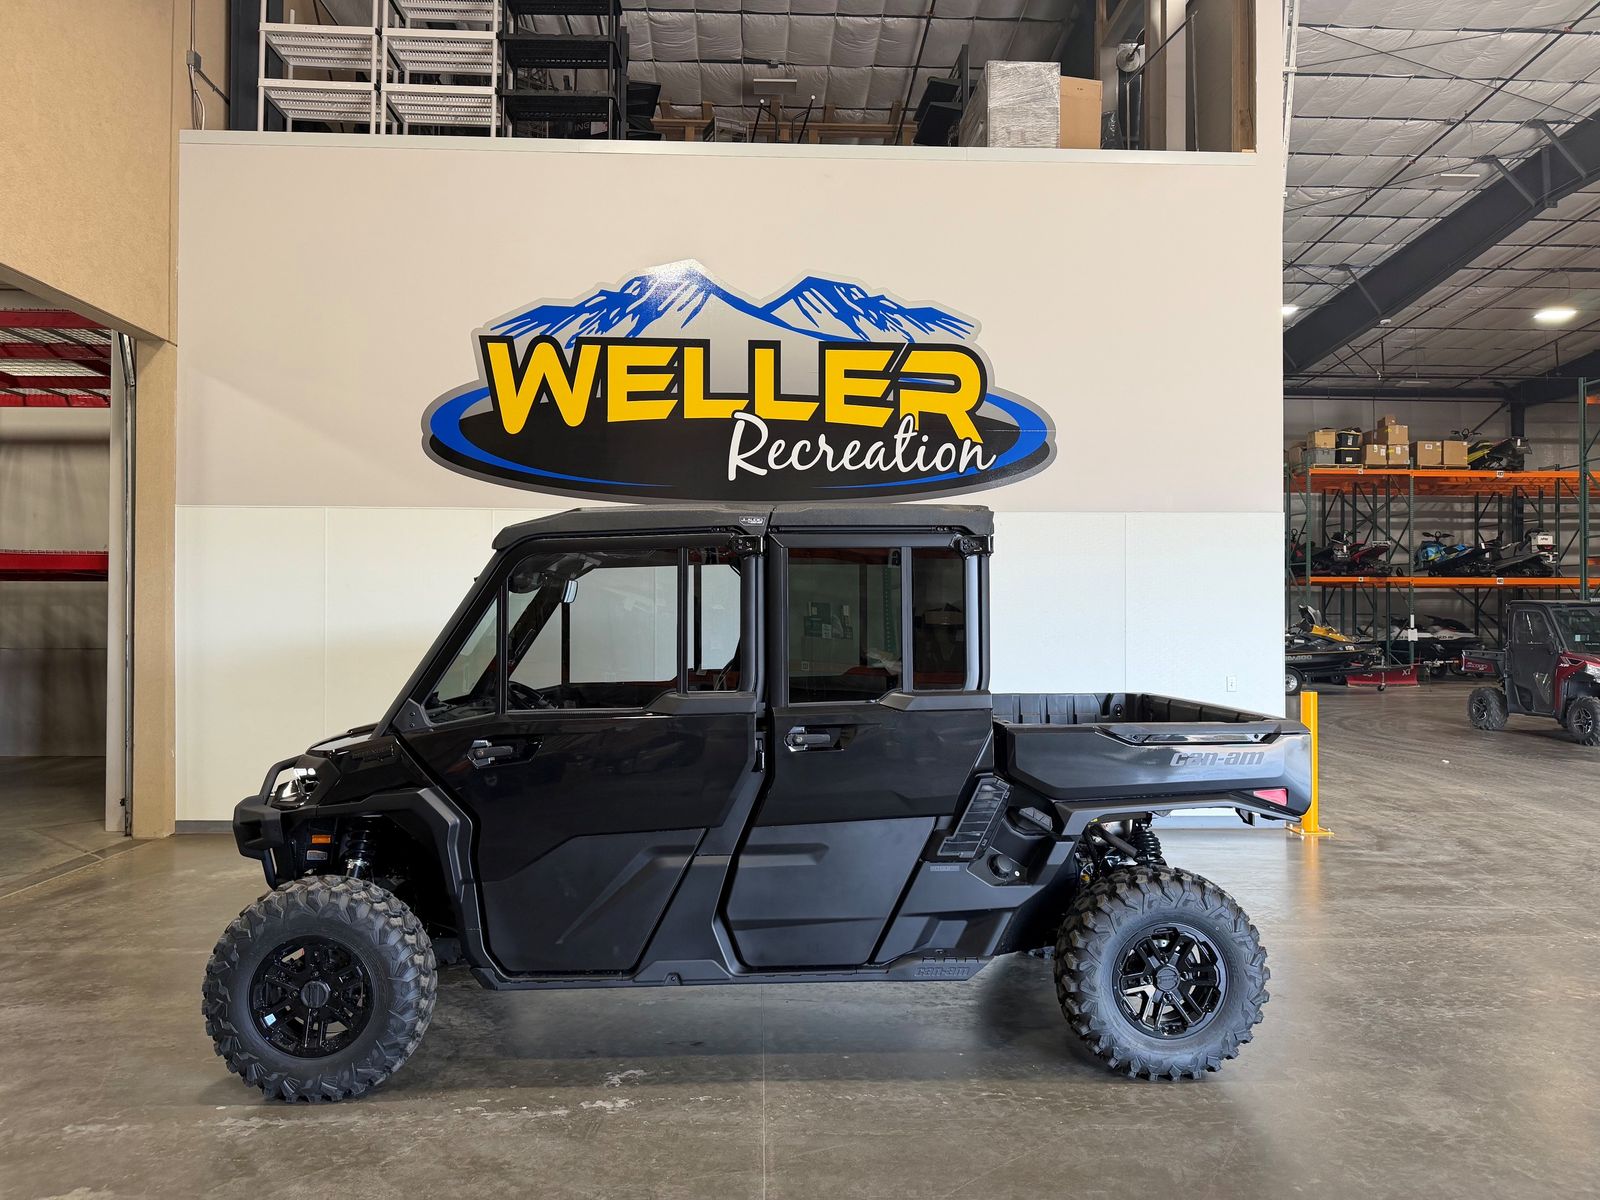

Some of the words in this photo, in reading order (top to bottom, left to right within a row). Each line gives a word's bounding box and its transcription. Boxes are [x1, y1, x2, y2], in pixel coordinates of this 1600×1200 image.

[486, 342, 984, 445] WELLER
[727, 411, 997, 481] Recreation
[1169, 751, 1265, 767] can-am
[913, 966, 971, 978] can-am
